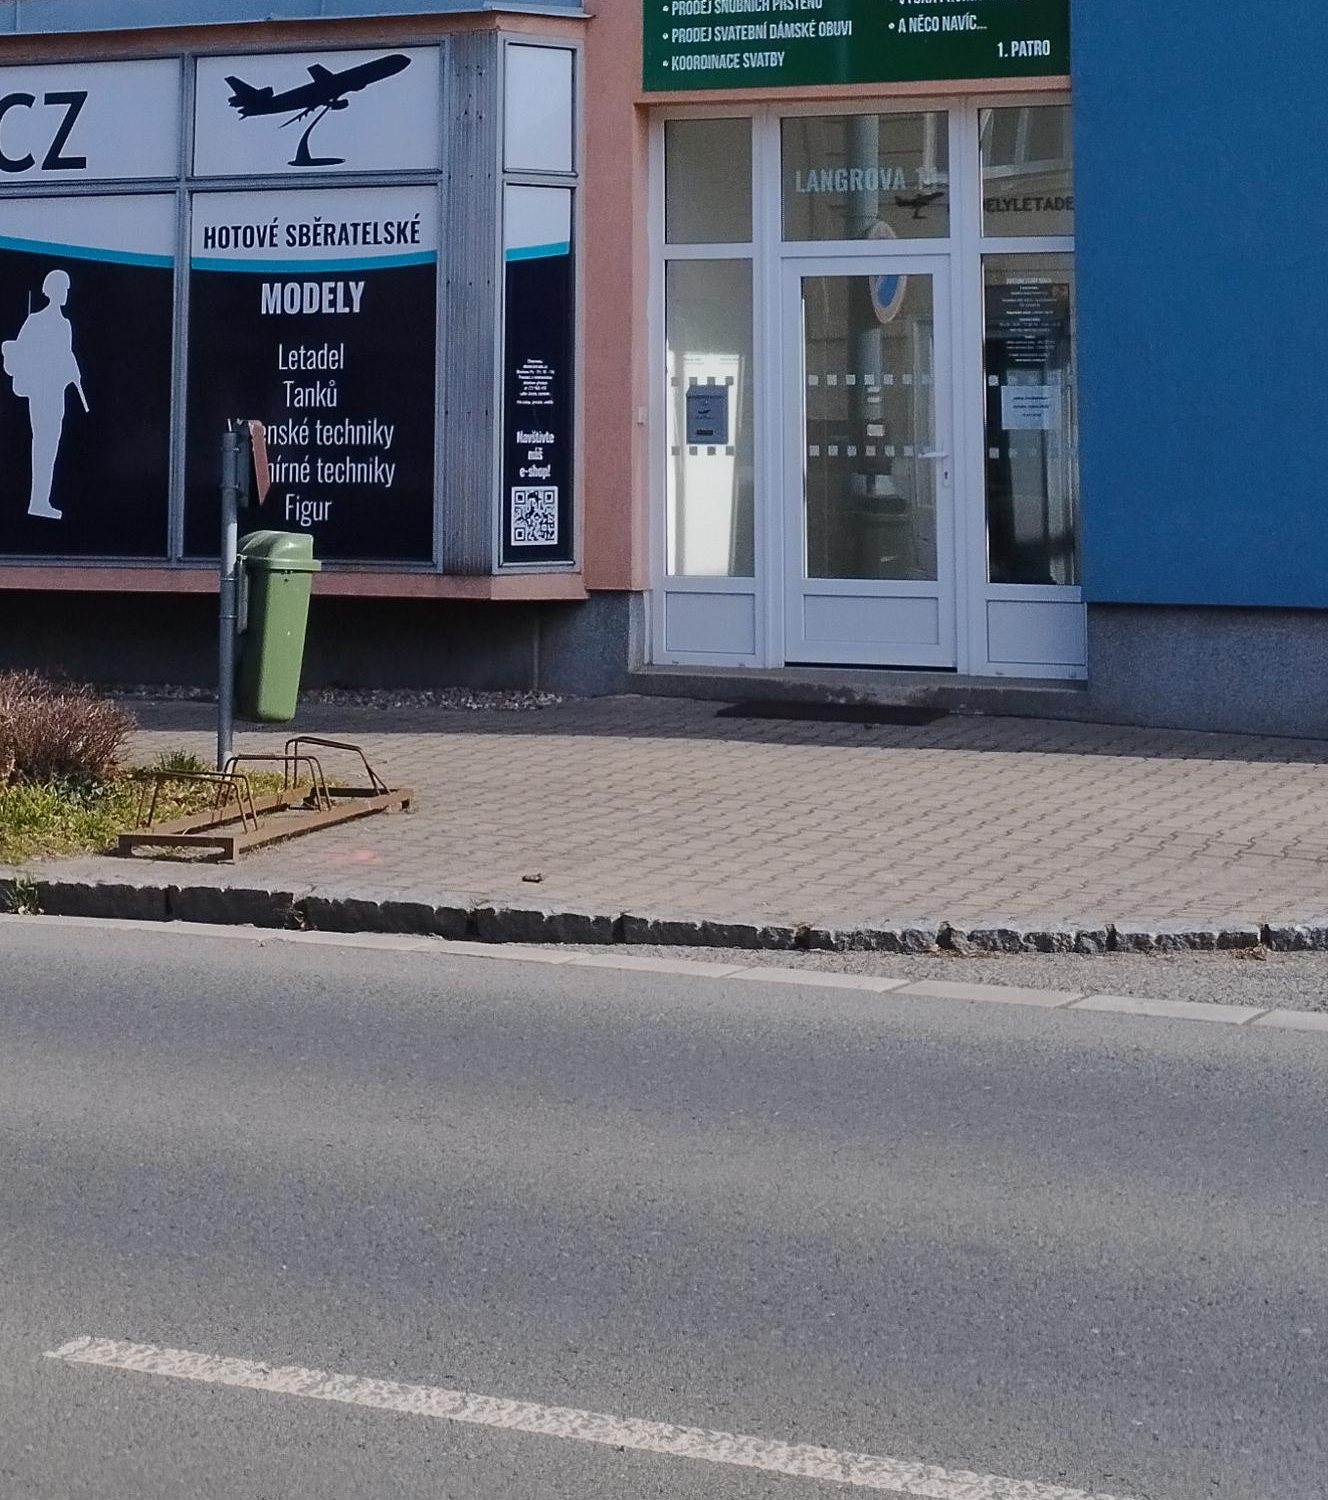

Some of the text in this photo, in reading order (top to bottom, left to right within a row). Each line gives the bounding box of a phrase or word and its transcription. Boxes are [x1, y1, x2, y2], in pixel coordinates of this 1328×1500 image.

[672, 0, 712, 16] PRODEJ
[672, 19, 852, 43] PRODEJ SVATEBNÍ DÁMSKÉ OBUVI
[897, 17, 907, 34] A
[908, 14, 939, 33] NĚCO
[672, 51, 785, 71] KOORDINACE SVATBY
[997, 40, 1051, 58] 1. PATRO
[795, 167, 906, 193] LANGROVA
[203, 213, 420, 249] HOTOVÉ SBĚRATELSKÉ
[261, 281, 365, 315] MODELY
[278, 343, 344, 370] Letadel
[283, 380, 338, 407] Tanků
[316, 417, 394, 449] techniky
[317, 455, 395, 488] techniky
[285, 493, 333, 527] Figur
